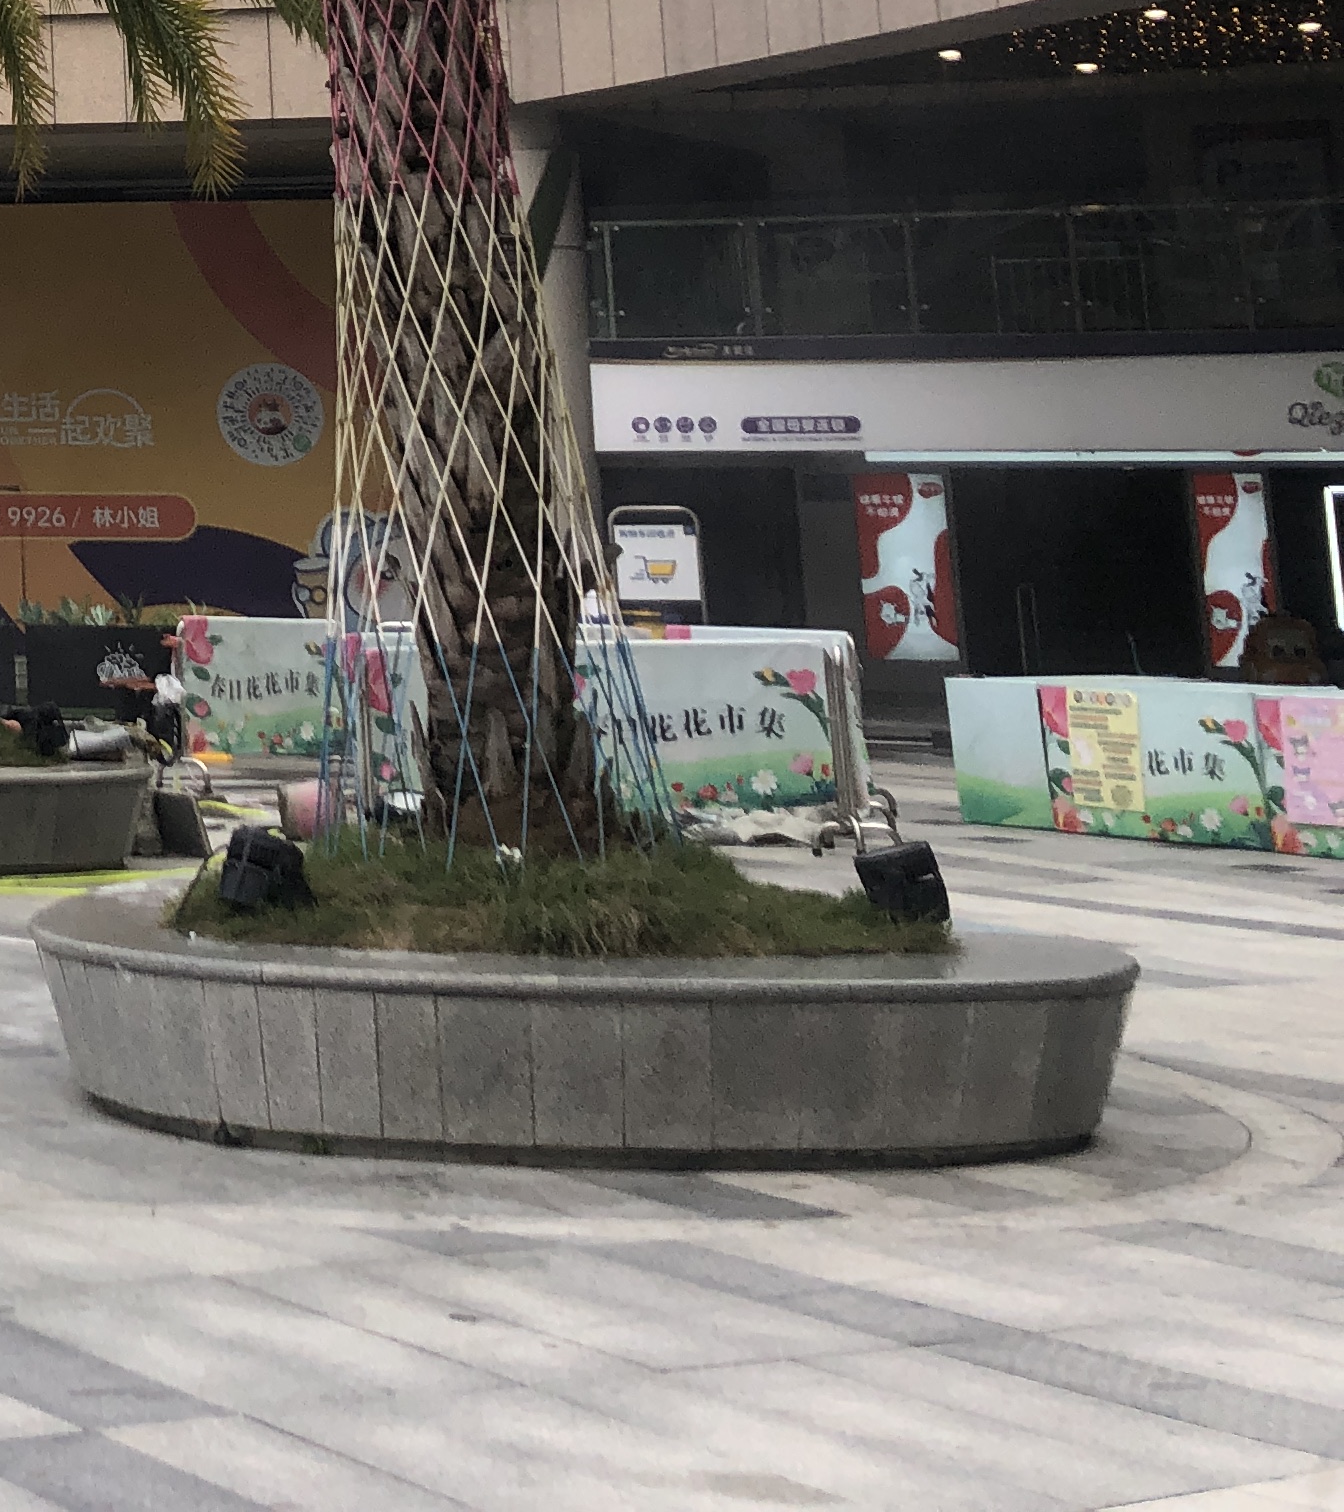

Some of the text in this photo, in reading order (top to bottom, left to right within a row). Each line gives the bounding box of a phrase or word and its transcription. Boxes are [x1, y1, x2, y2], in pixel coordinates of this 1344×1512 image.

[7, 506, 66, 527] 9926
[92, 506, 160, 528] 林小姐
